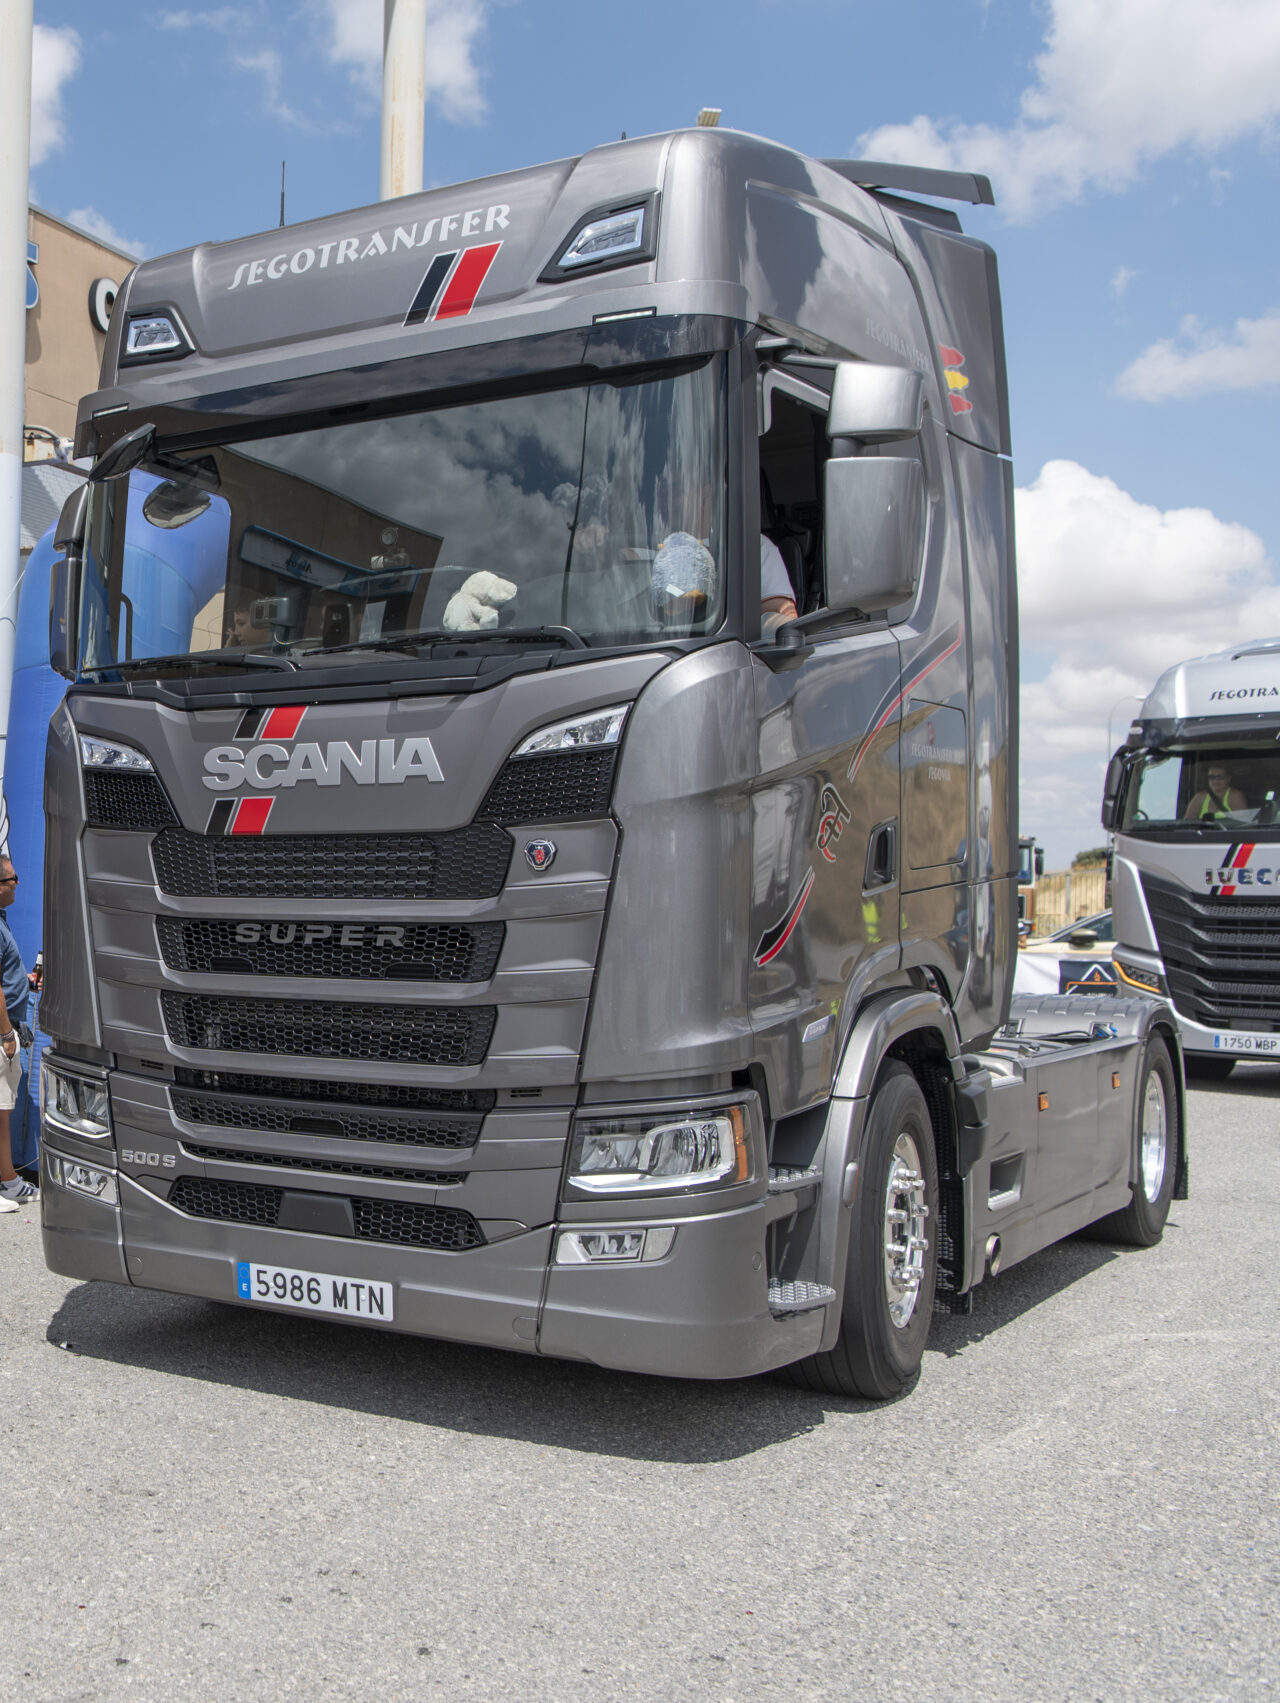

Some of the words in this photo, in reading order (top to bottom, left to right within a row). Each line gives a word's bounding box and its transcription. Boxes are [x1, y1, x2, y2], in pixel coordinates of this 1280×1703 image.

[227, 204, 511, 290] SEGOTRANSFER
[202, 737, 445, 791] SCANIA
[235, 923, 405, 947] SUPER
[1224, 1037, 1252, 1049] 1750
[1255, 1040, 1278, 1050] MBP
[121, 1149, 159, 1166] 500
[162, 1154, 176, 1168] S
[256, 1269, 322, 1305] 5986
[333, 1280, 384, 1315] MTN
